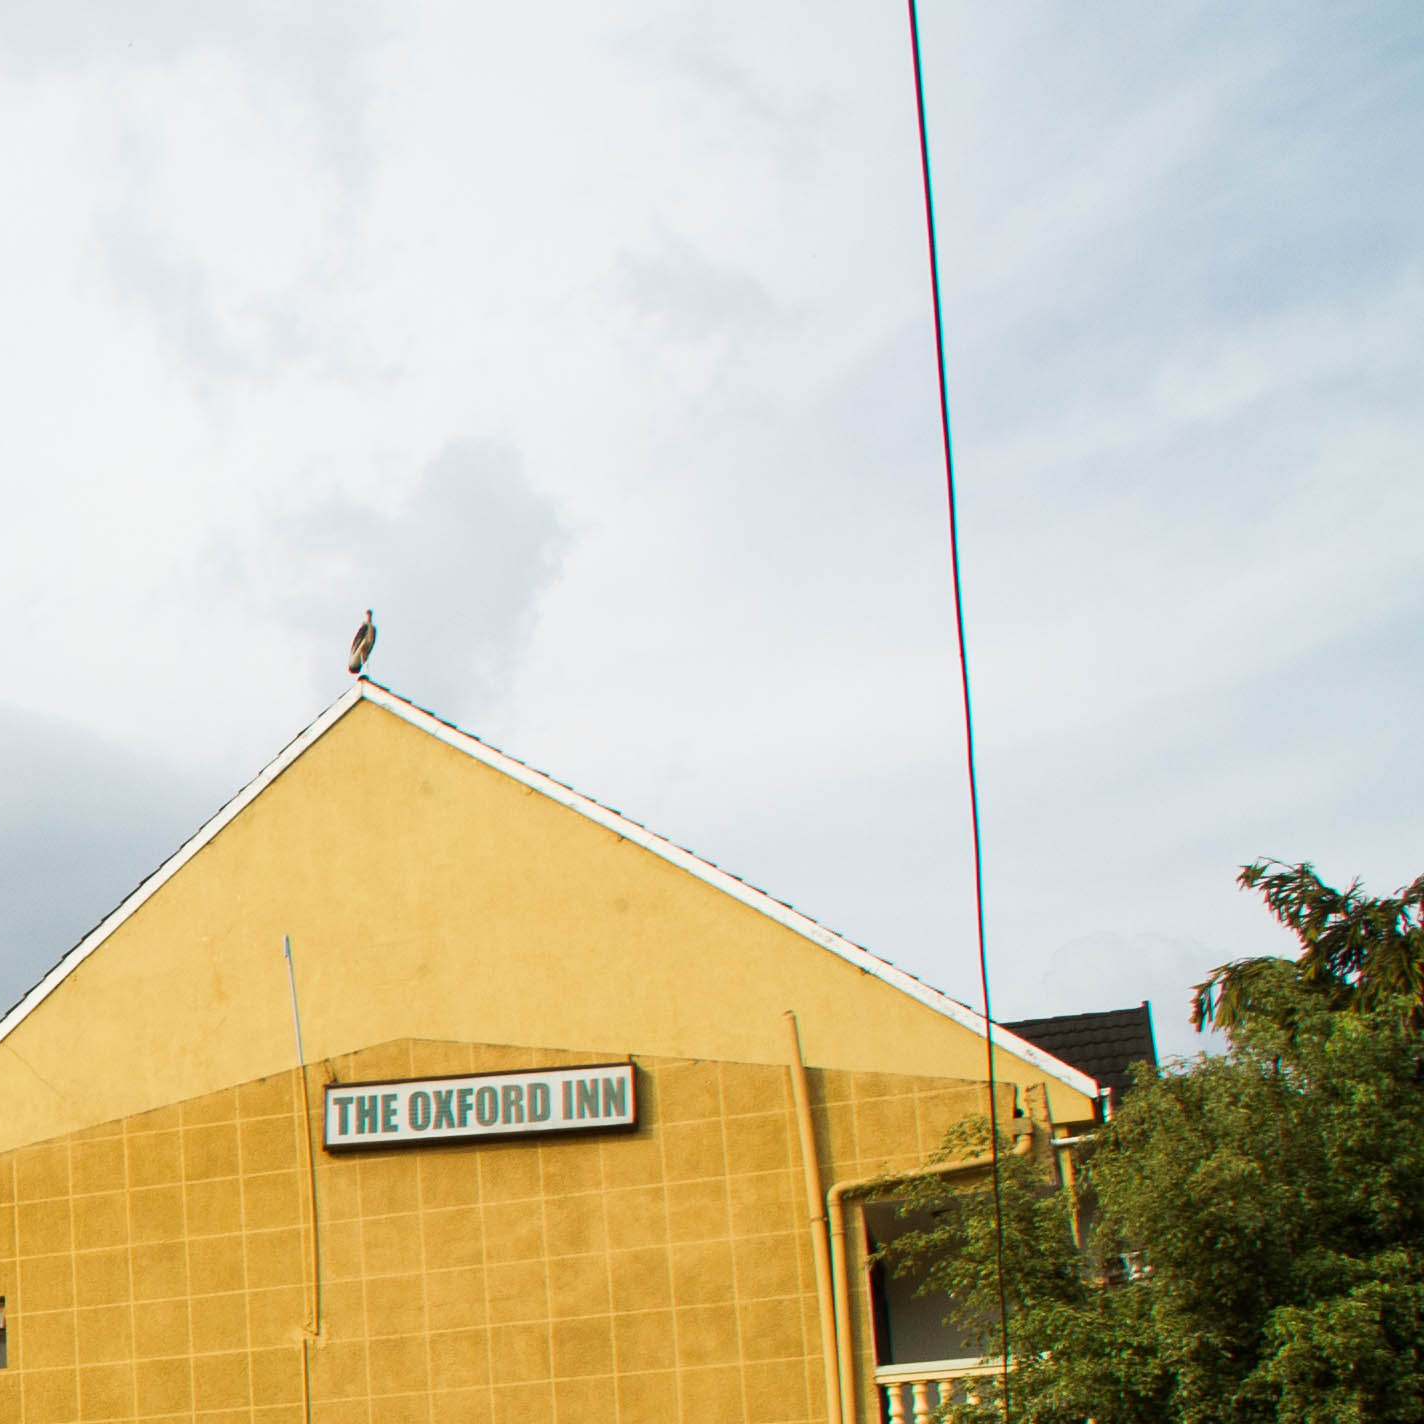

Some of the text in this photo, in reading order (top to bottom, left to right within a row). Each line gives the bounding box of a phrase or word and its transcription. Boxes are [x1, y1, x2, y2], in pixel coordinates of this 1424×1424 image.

[332, 1076, 628, 1136] THE OXFORD INN
